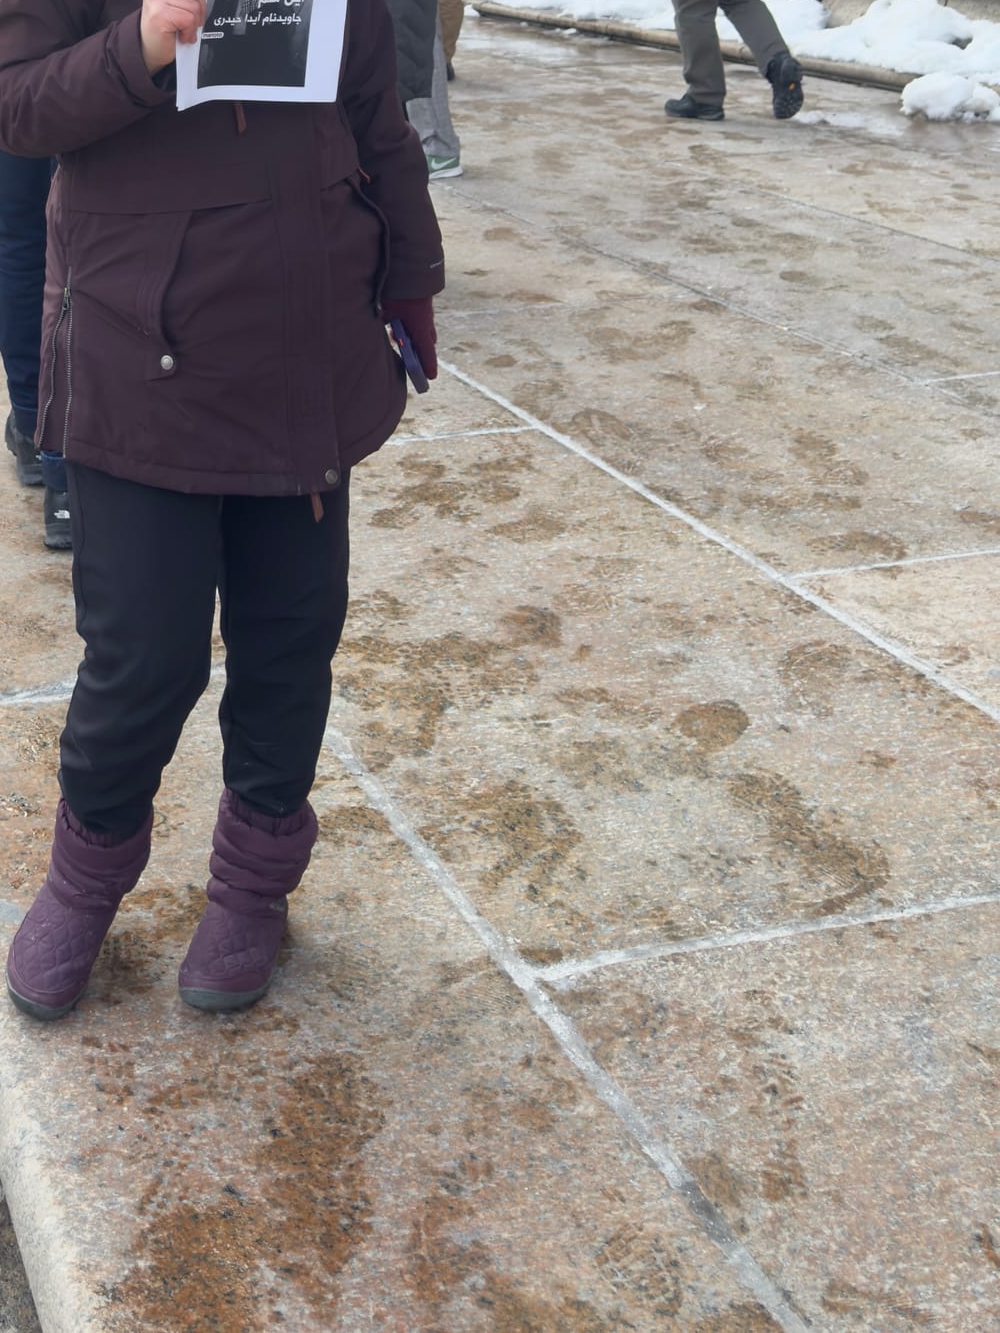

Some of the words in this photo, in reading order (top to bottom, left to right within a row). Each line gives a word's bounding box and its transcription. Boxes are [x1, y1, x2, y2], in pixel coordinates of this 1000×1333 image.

[213, 14, 242, 26] حیدری
[244, 10, 263, 24] آیدا
[261, 12, 301, 26] جاویدنام
